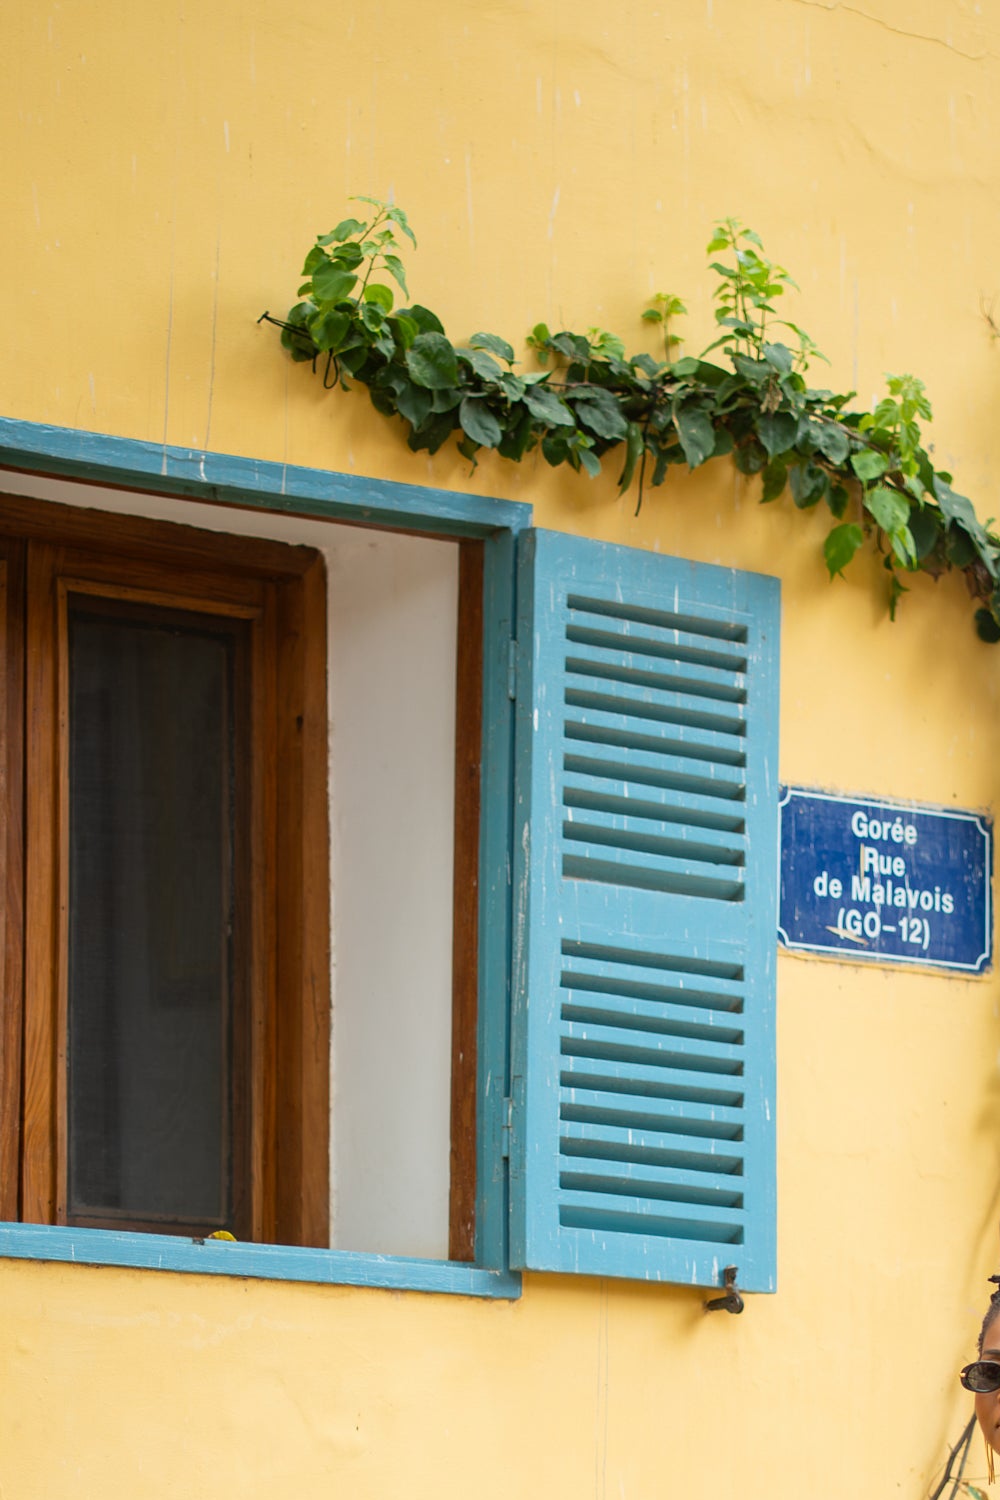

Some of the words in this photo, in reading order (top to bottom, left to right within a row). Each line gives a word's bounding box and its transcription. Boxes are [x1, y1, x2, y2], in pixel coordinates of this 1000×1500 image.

[851, 811, 918, 845] Gorée
[864, 846, 906, 876] Rue
[813, 871, 843, 898] de
[851, 875, 954, 914] Malavois
[837, 907, 930, 950] (GO-12)
